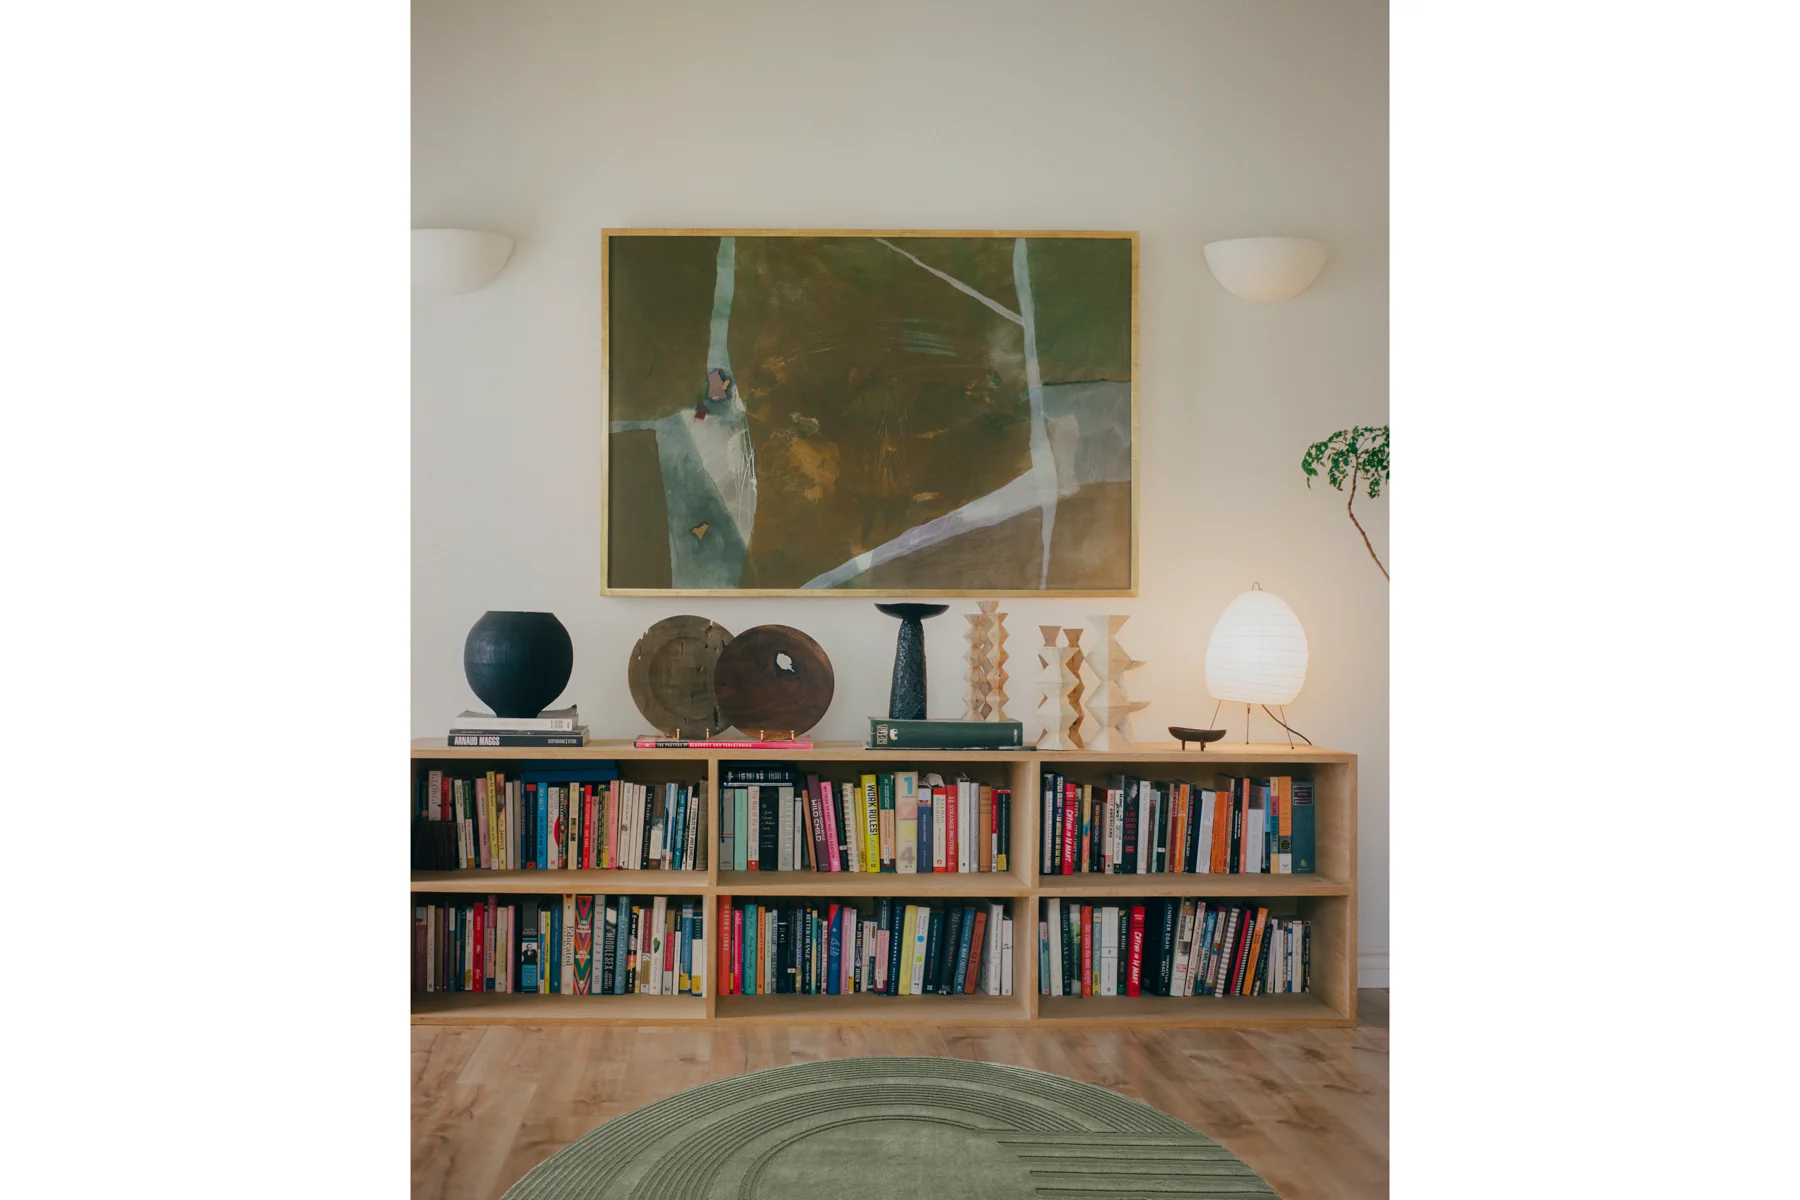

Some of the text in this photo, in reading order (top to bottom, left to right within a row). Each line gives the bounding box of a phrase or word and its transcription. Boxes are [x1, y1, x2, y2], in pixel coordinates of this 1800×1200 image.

[454, 736, 500, 746] ARNAUD MAGGS
[904, 776, 914, 795] 1
[868, 784, 878, 836] WORK RULES!
[1066, 809, 1074, 830] CRYING
[814, 818, 822, 842] CHILD
[1065, 836, 1072, 845] H
[1064, 844, 1072, 862] MART
[566, 926, 574, 966] Educated
[605, 932, 615, 970] MIDDLESEX
[1134, 932, 1142, 953] CRYING
[959, 958, 967, 974] CALLED
[1132, 960, 1140, 968] H
[1132, 966, 1140, 984] MART
